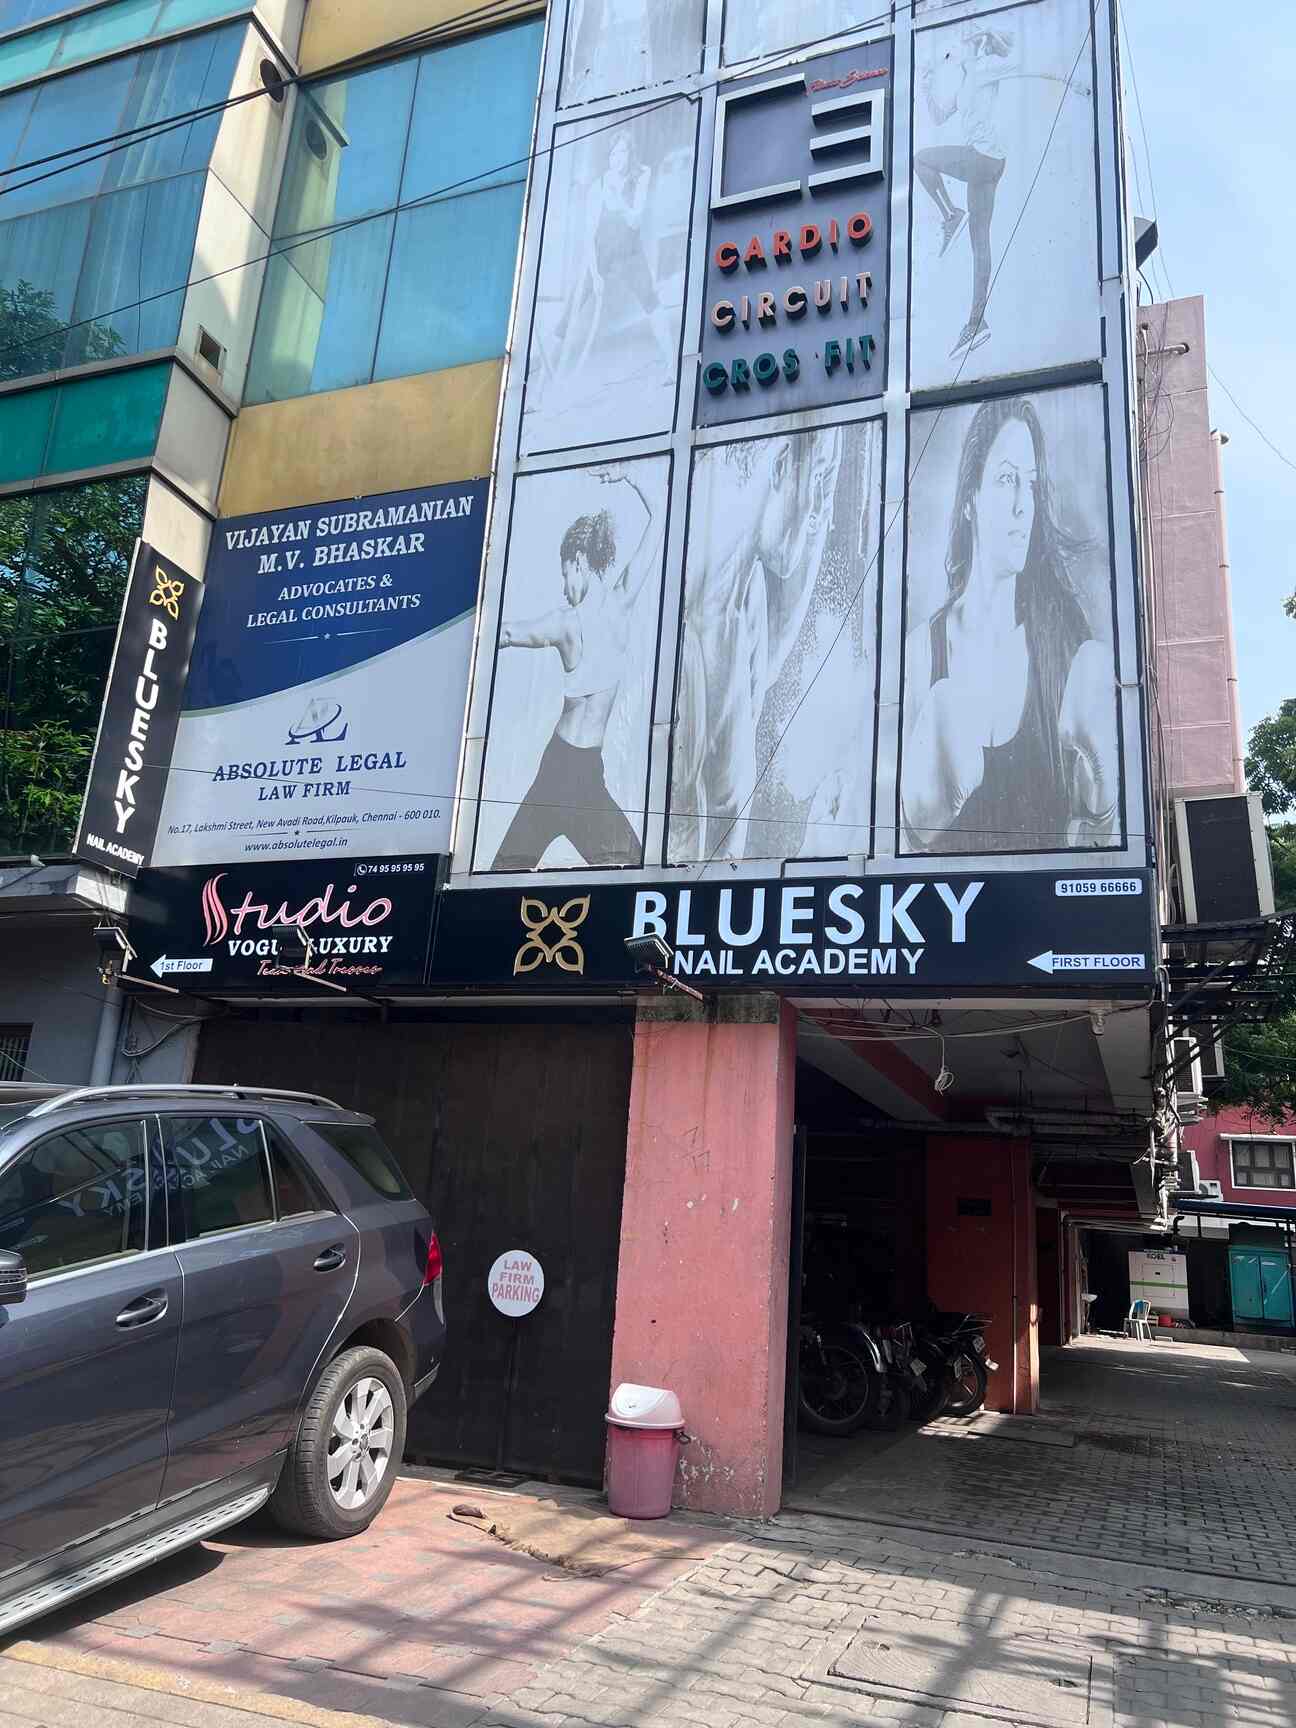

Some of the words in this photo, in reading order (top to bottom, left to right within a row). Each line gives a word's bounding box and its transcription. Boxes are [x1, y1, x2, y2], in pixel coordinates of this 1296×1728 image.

[714, 211, 872, 273] CARDIO
[710, 271, 873, 333] CIRCUIT
[702, 348, 800, 395] CROS
[824, 334, 876, 375] FIT
[225, 519, 311, 551] VIJAYAN
[316, 496, 474, 538] SUBRAMANIAN
[257, 549, 305, 575] M.V.
[313, 532, 426, 568] BHASKAR
[278, 575, 377, 602] ADVOCATES
[379, 573, 393, 589] &
[246, 609, 298, 628] LEGAL
[301, 593, 421, 622] CONSULTANTS
[113, 617, 169, 834] BLUESKY
[212, 757, 323, 782] ABSOLUTE
[335, 751, 407, 773] LEGAL
[257, 784, 297, 801] LAW
[303, 780, 351, 798] FIRM
[195, 821, 227, 833] Lakshmi
[228, 819, 254, 832] Street,
[256, 819, 274, 829] New
[276, 816, 301, 827] Avadi
[362, 810, 398, 823] Chennai
[404, 809, 421, 820] 600
[86, 833, 106, 851] NAIL
[105, 842, 145, 866] ACADEMY
[244, 837, 348, 852] www.absolutelegal.in
[368, 864, 378, 873] 74
[379, 864, 390, 873] 95
[391, 864, 401, 872] 95
[402, 863, 413, 872] 95
[414, 863, 425, 871] 95
[1061, 882, 1097, 894] 91059
[1100, 881, 1137, 893] 66666
[201, 873, 393, 947] Studio
[632, 881, 985, 946] BLUESKY
[228, 939, 283, 956] VOGU
[673, 949, 744, 975] NAIL
[751, 948, 925, 975] ACADEMY
[1052, 957, 1089, 967] FIRST
[1094, 956, 1141, 967] FLOOR
[160, 960, 175, 972] 1st
[176, 960, 204, 972] Floor
[499, 1271, 535, 1285] FIRM
[503, 1259, 533, 1272] LAW
[492, 1282, 540, 1304] PARKING
